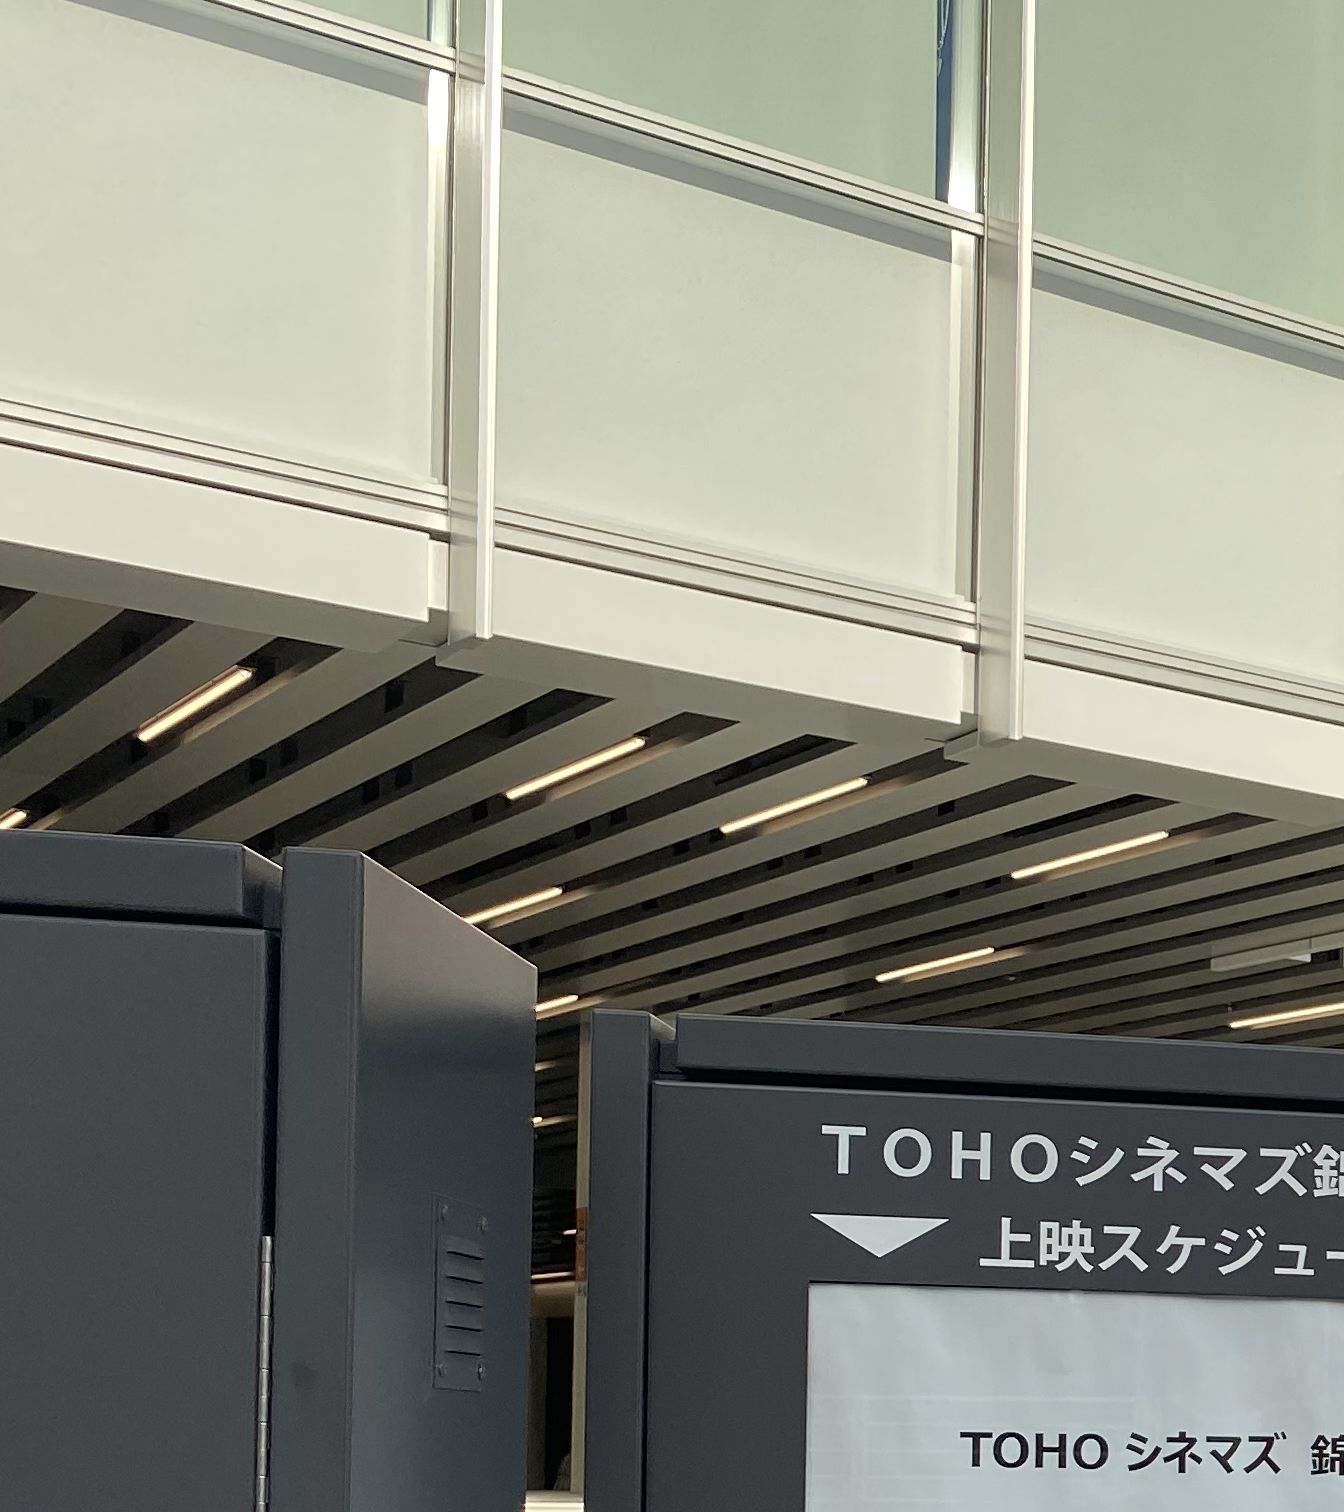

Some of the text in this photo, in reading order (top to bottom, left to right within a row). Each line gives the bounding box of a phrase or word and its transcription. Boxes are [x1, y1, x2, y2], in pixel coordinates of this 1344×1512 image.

[959, 1431, 1110, 1471] TOHO
[1125, 1431, 1287, 1476] シネマズ
